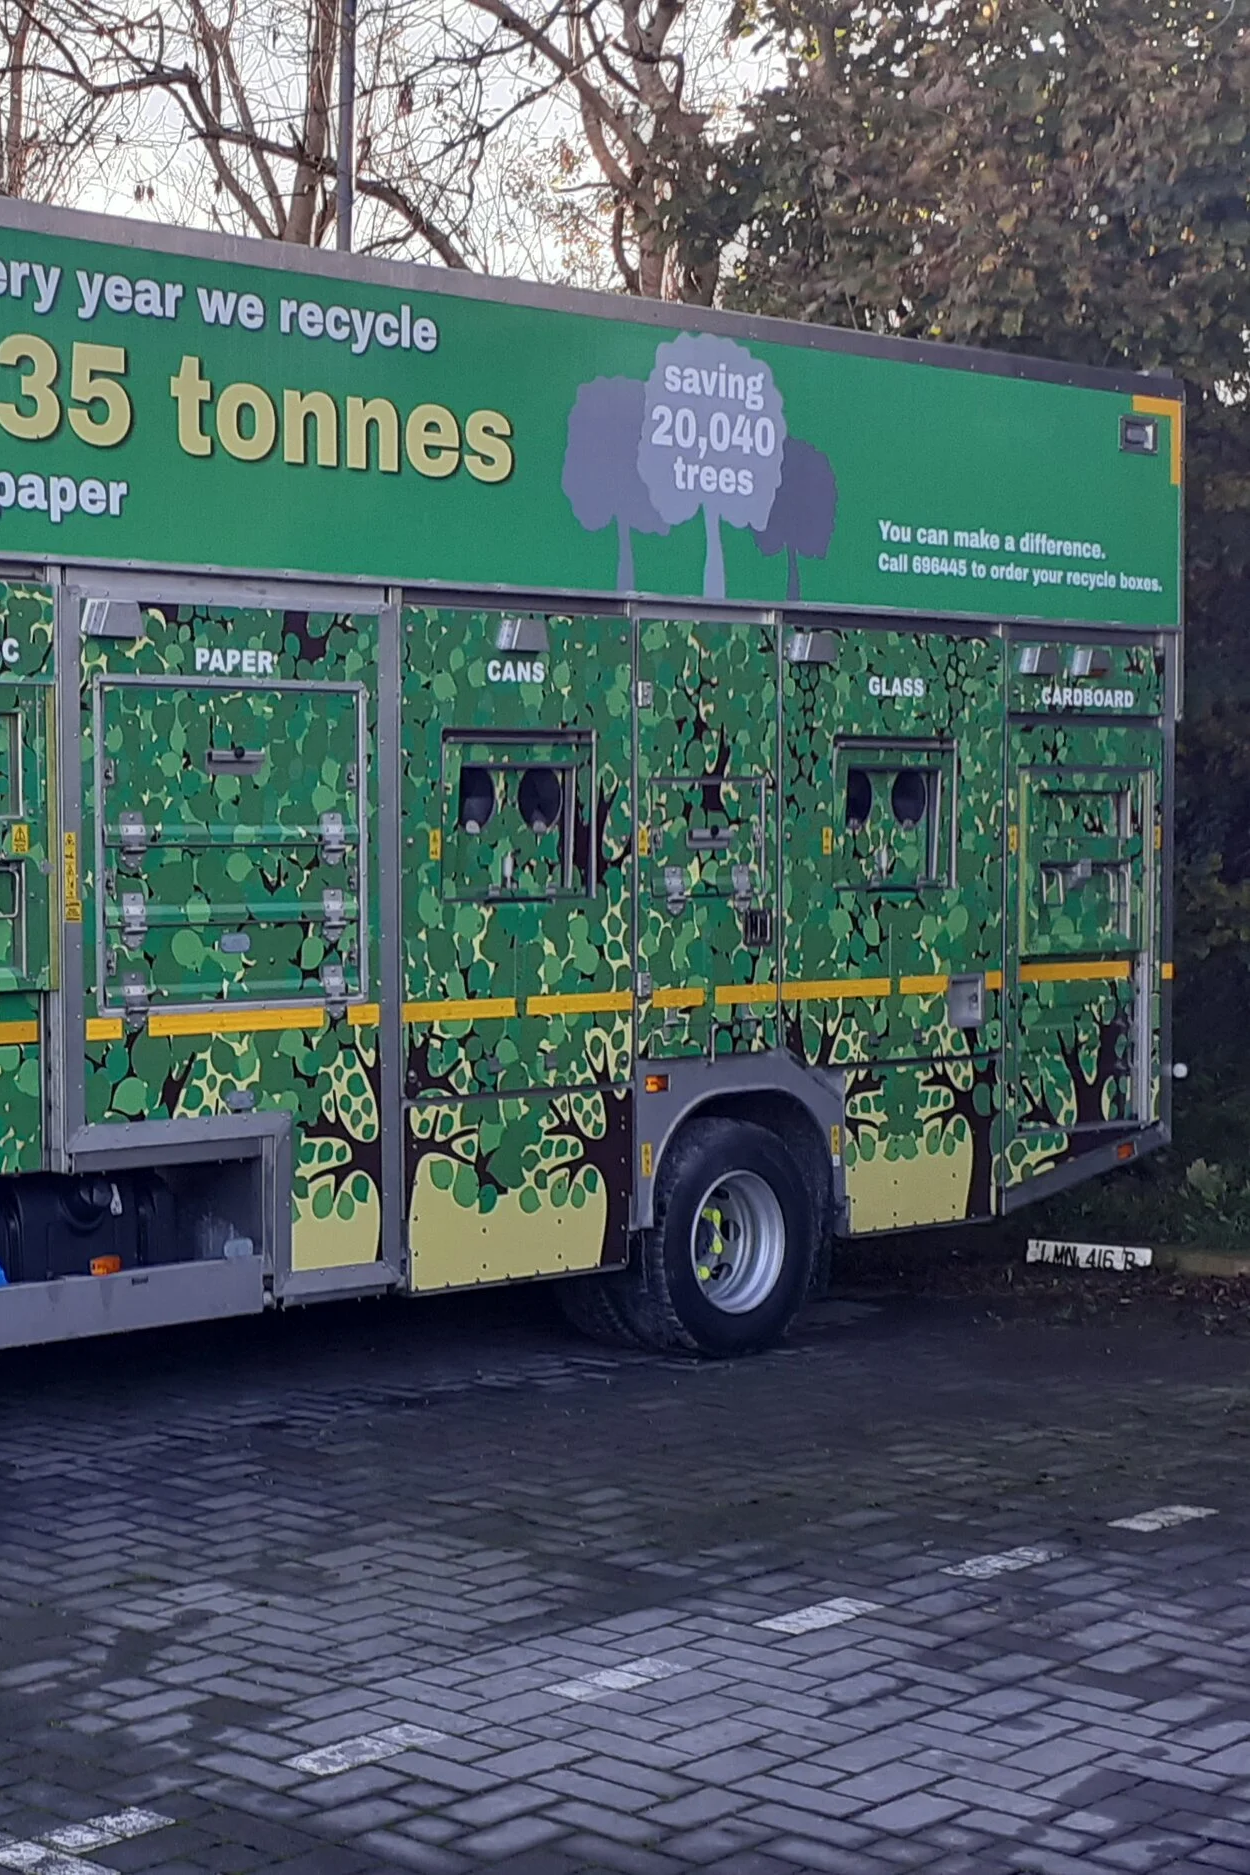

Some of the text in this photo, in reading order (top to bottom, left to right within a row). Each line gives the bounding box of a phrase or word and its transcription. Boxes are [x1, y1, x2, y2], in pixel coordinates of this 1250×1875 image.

[76, 268, 184, 320] year
[197, 285, 265, 331] we
[279, 304, 439, 355] recycle
[664, 363, 765, 411] saving
[170, 355, 515, 484] tonnes
[651, 405, 775, 460] 20,040
[673, 455, 754, 496] trees
[878, 519, 1106, 560] You can make a difference.
[878, 552, 1163, 592] Call 696445 to order your recycle boxes.
[195, 647, 274, 674] PAPER
[487, 659, 546, 684] CANS
[868, 675, 925, 698] GLASS
[1041, 686, 1135, 709] CARDBOARD
